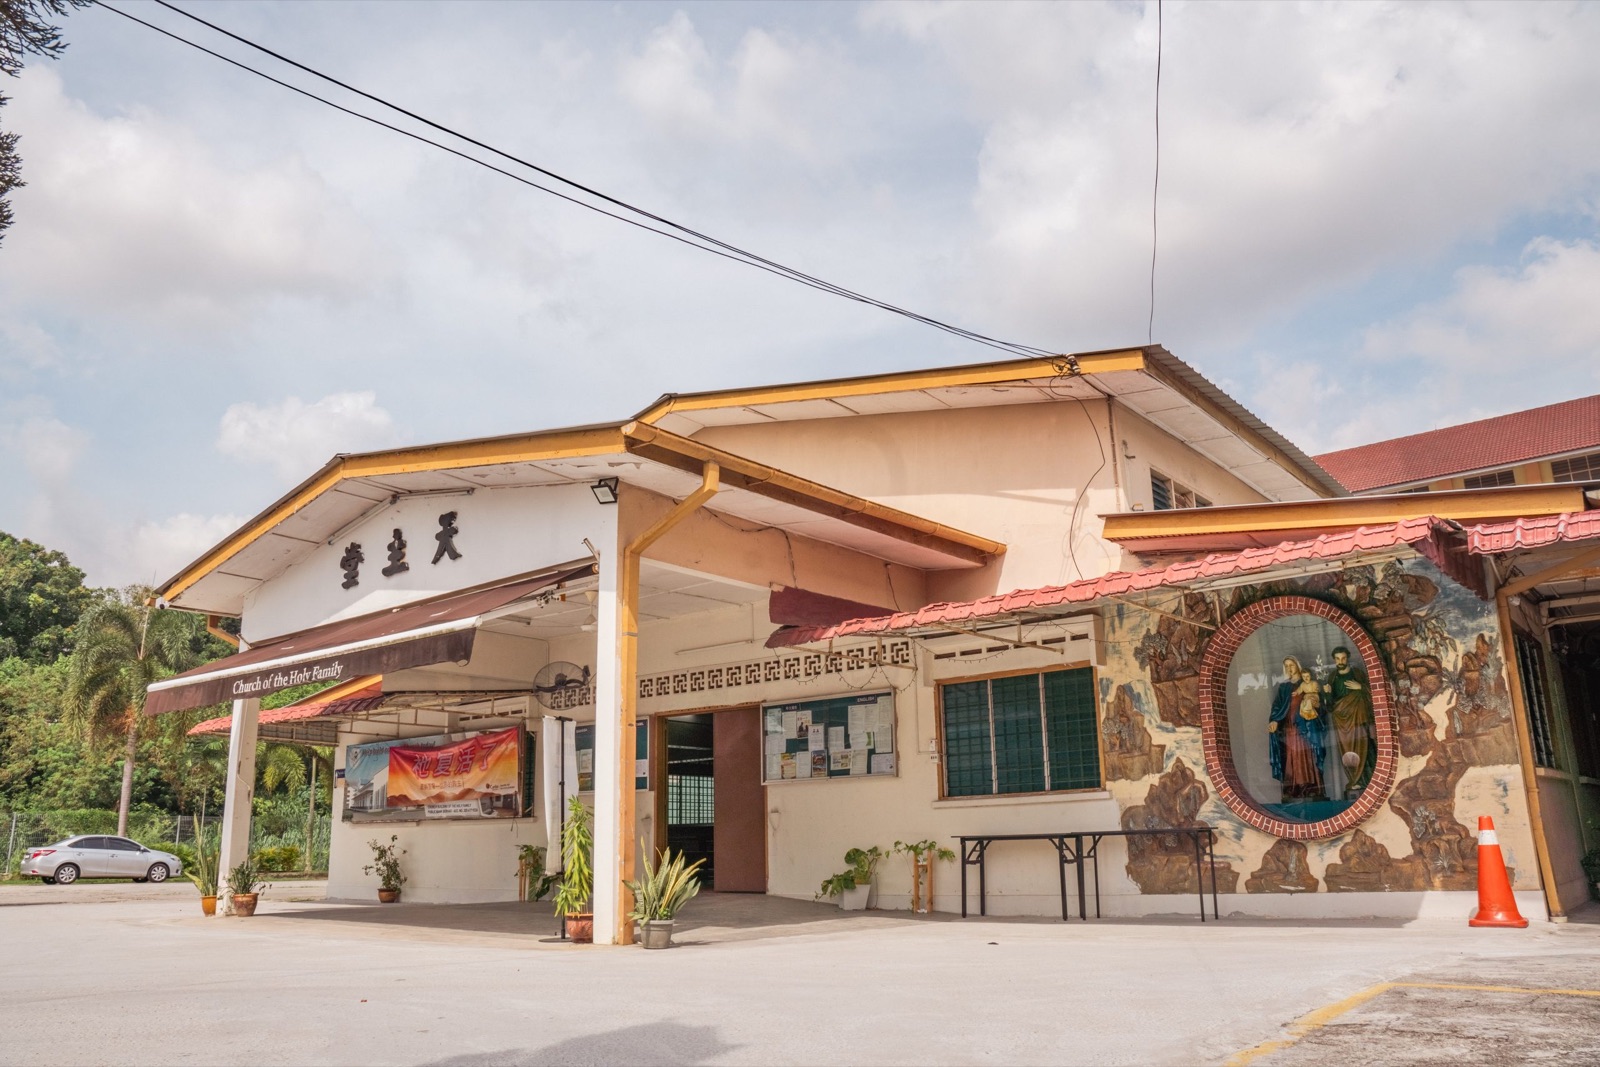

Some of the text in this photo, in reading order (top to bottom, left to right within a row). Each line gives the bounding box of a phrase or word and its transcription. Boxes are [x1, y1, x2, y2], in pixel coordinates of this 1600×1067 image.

[232, 661, 344, 694] Church of the Holy Family
